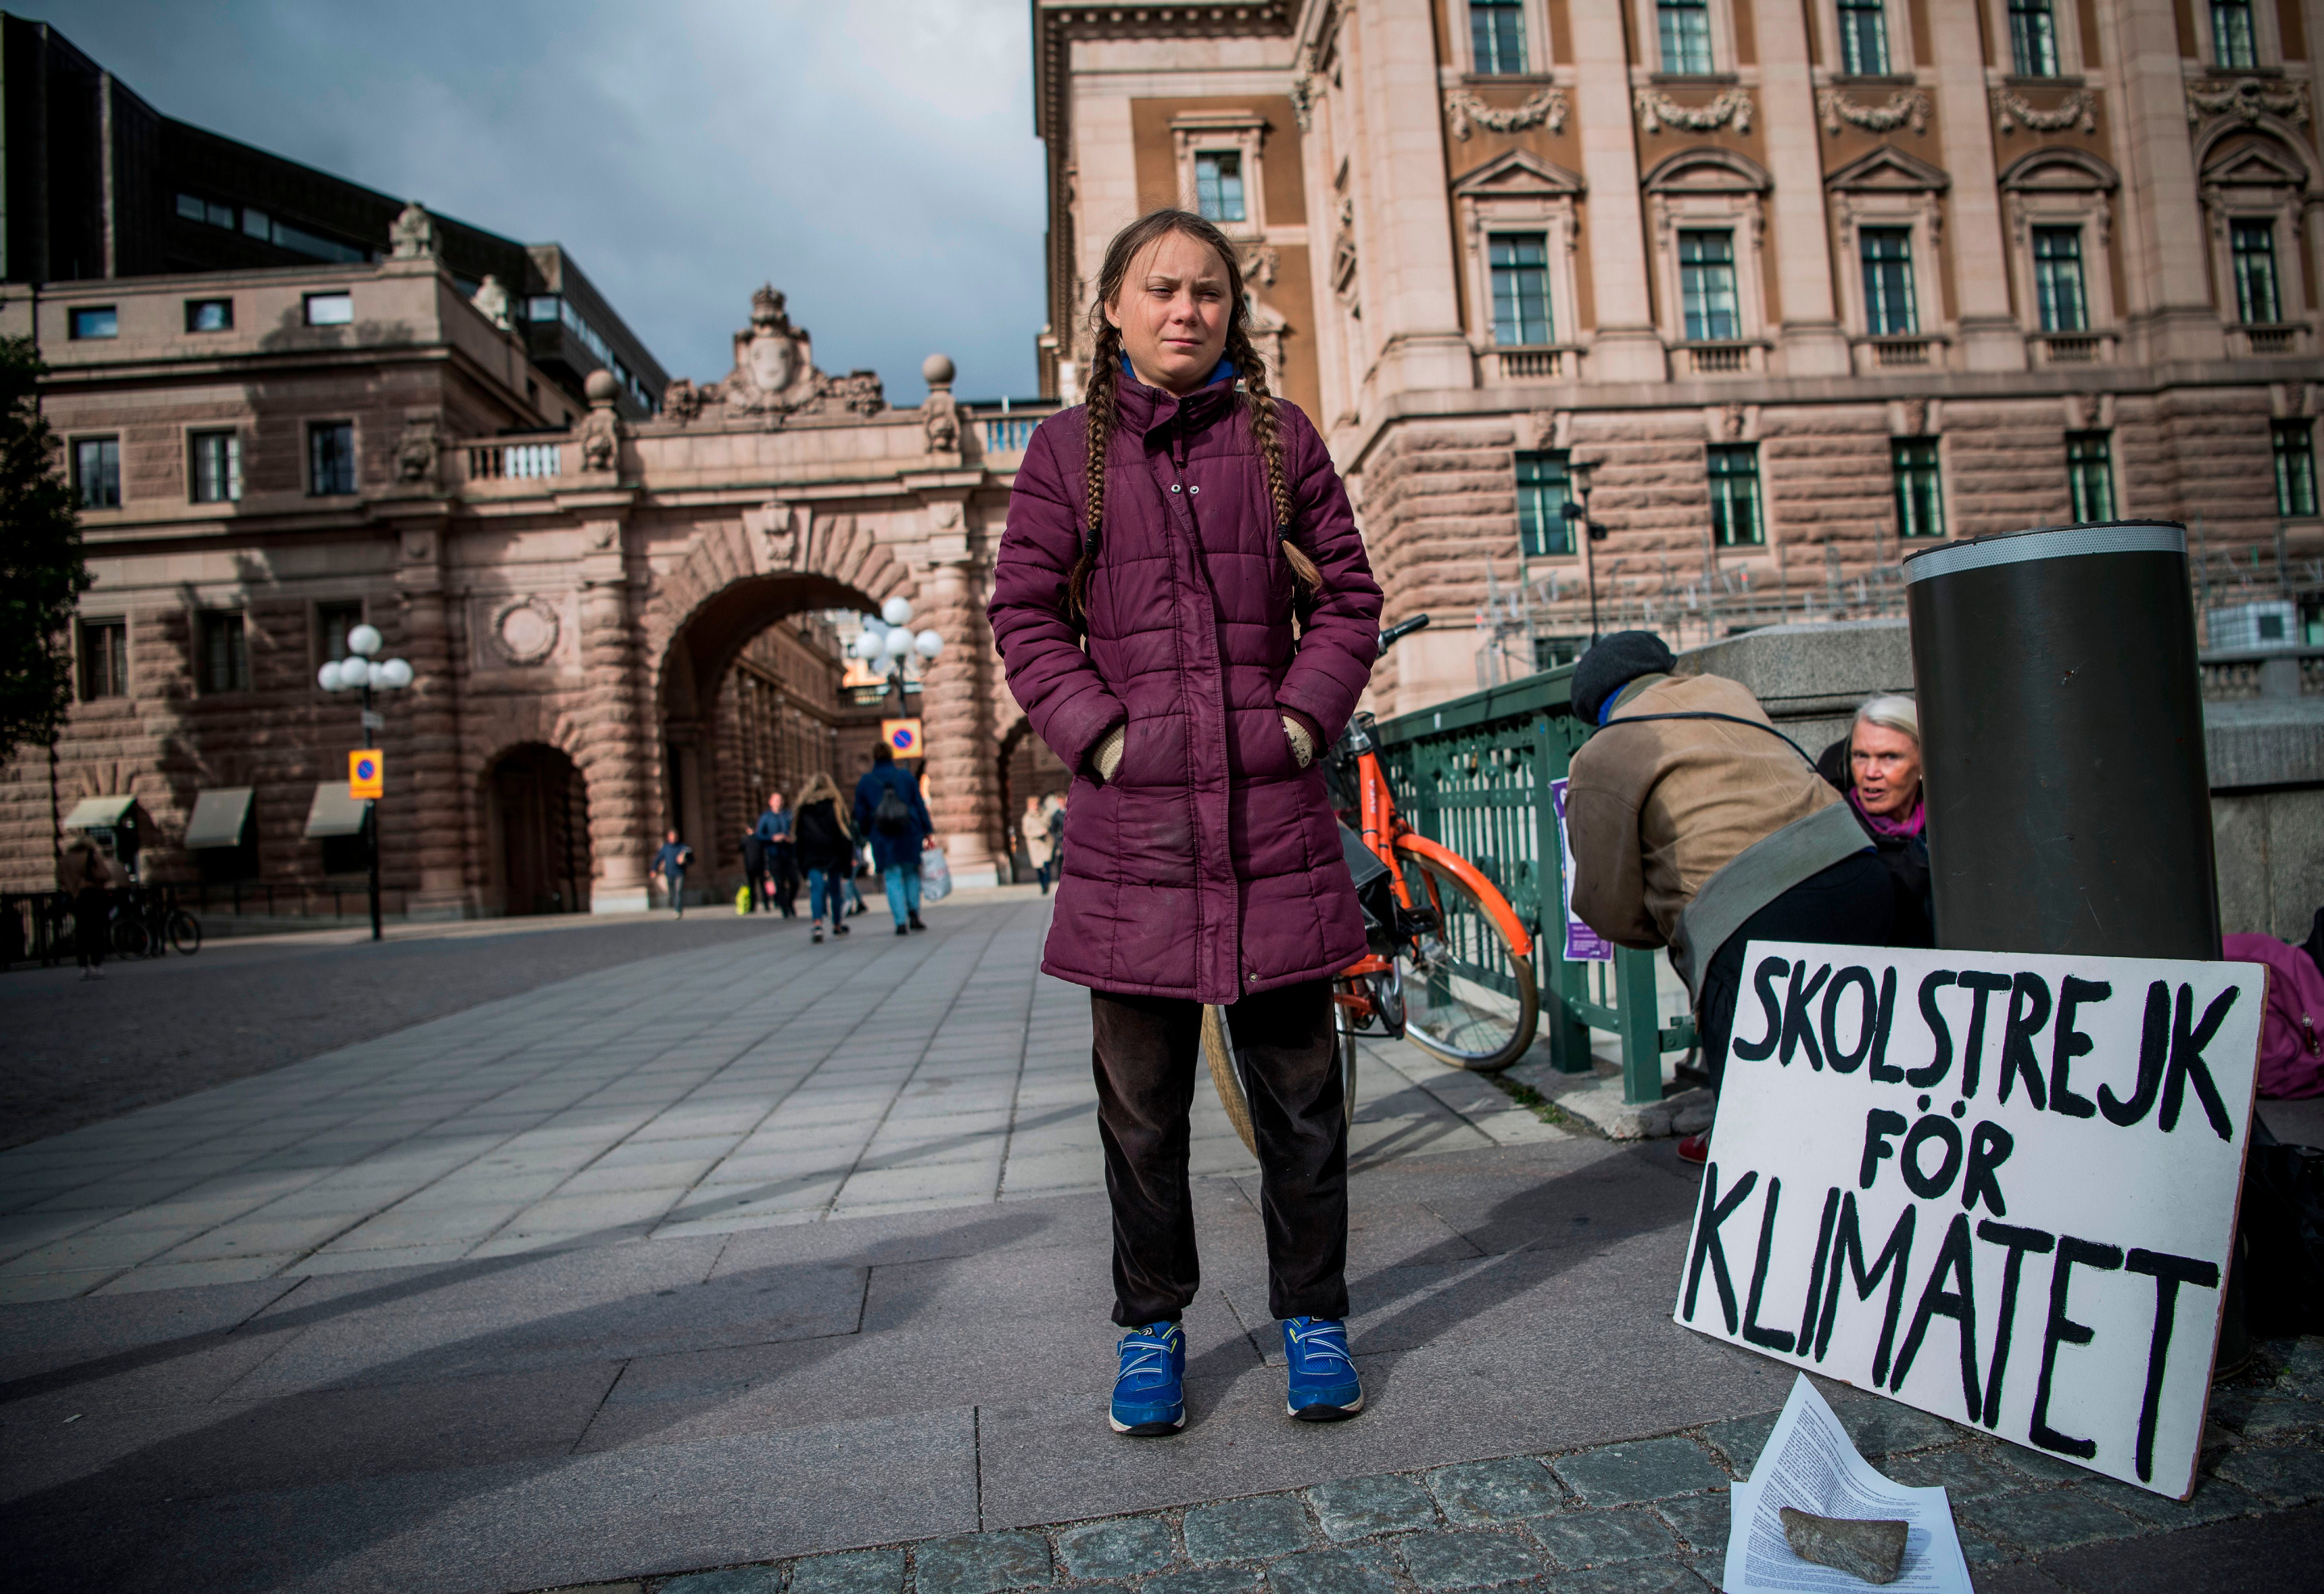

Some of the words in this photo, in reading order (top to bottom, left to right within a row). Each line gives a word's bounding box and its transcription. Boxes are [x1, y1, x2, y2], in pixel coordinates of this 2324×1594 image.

[1733, 957, 2238, 1141] SKOLSTREJK
[1860, 1096, 2013, 1216] FÖR
[1683, 1161, 2219, 1483] KLIMATET
